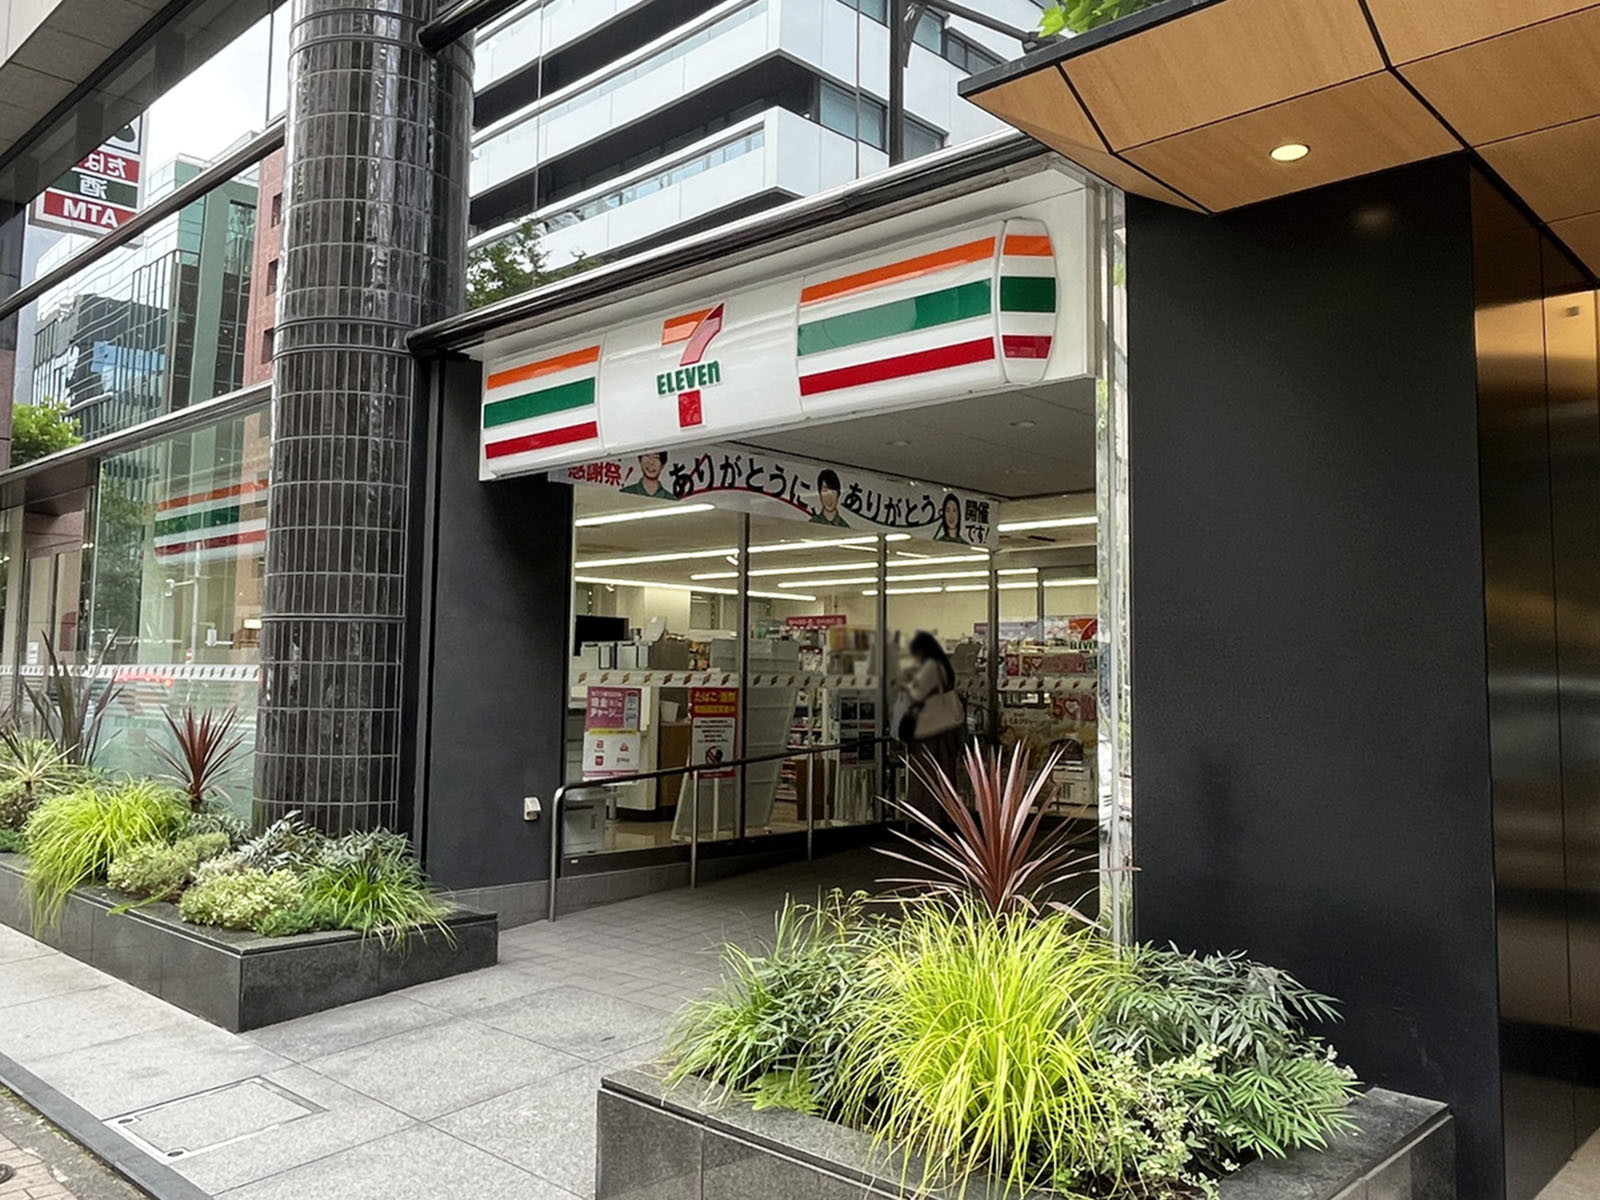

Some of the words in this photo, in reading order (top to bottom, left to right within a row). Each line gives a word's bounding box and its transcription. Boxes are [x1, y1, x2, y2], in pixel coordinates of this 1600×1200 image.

[843, 483, 936, 526] ありがとう
